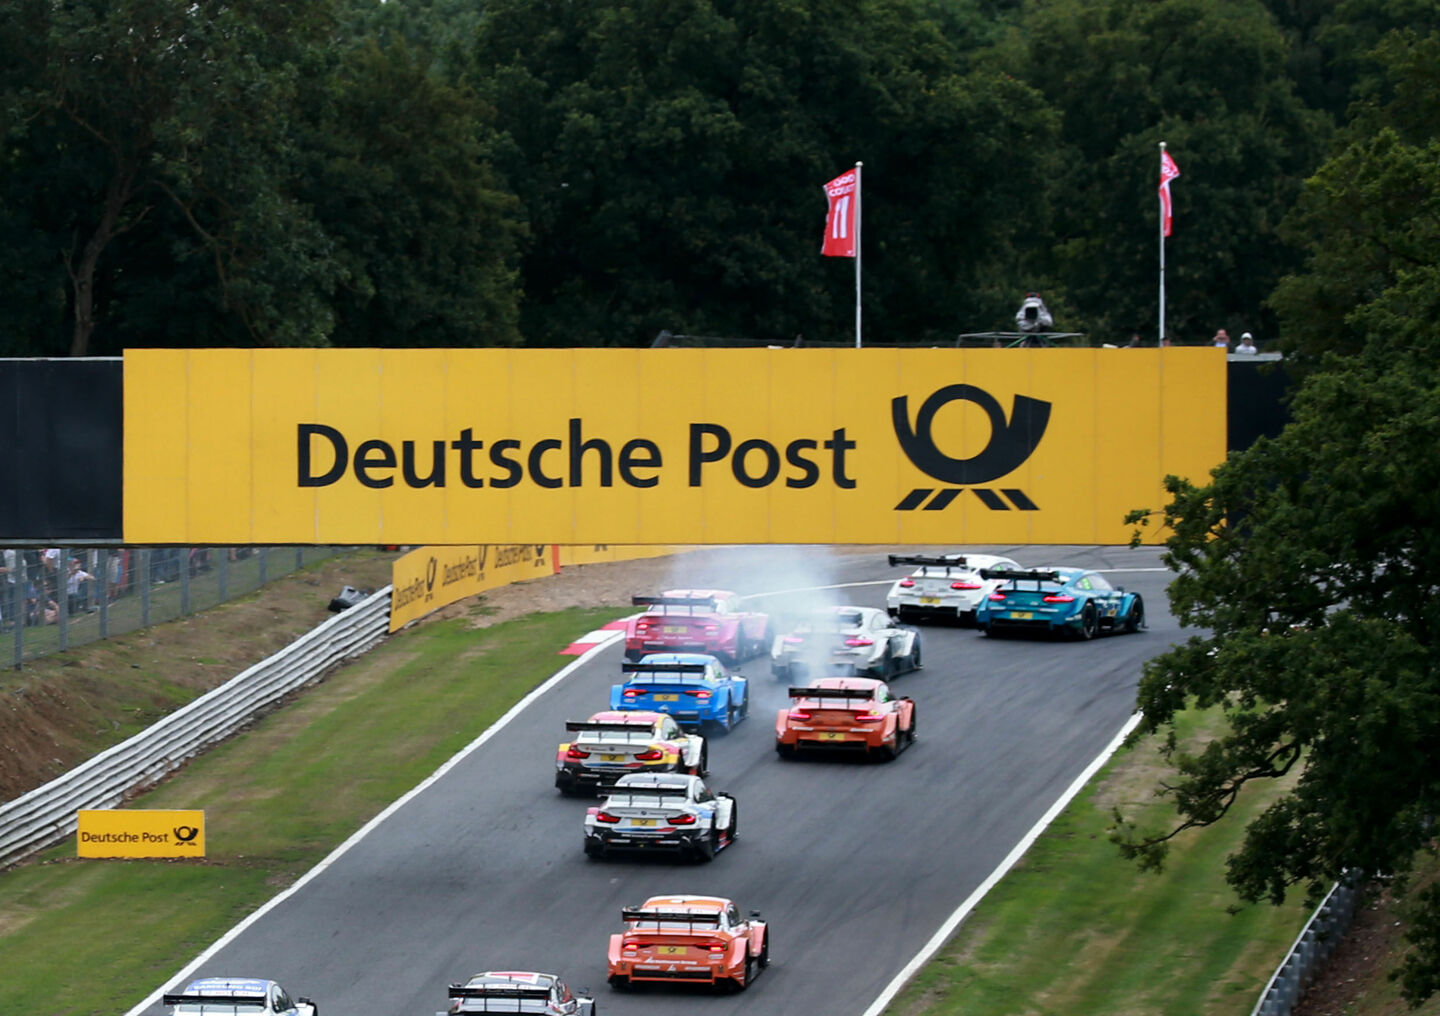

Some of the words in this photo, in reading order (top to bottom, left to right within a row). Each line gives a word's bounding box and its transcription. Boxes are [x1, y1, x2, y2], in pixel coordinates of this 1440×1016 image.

[296, 417, 663, 490] Deutsche
[688, 422, 857, 490] Post
[81, 831, 139, 843] Deutsche
[142, 832, 169, 843] Post
